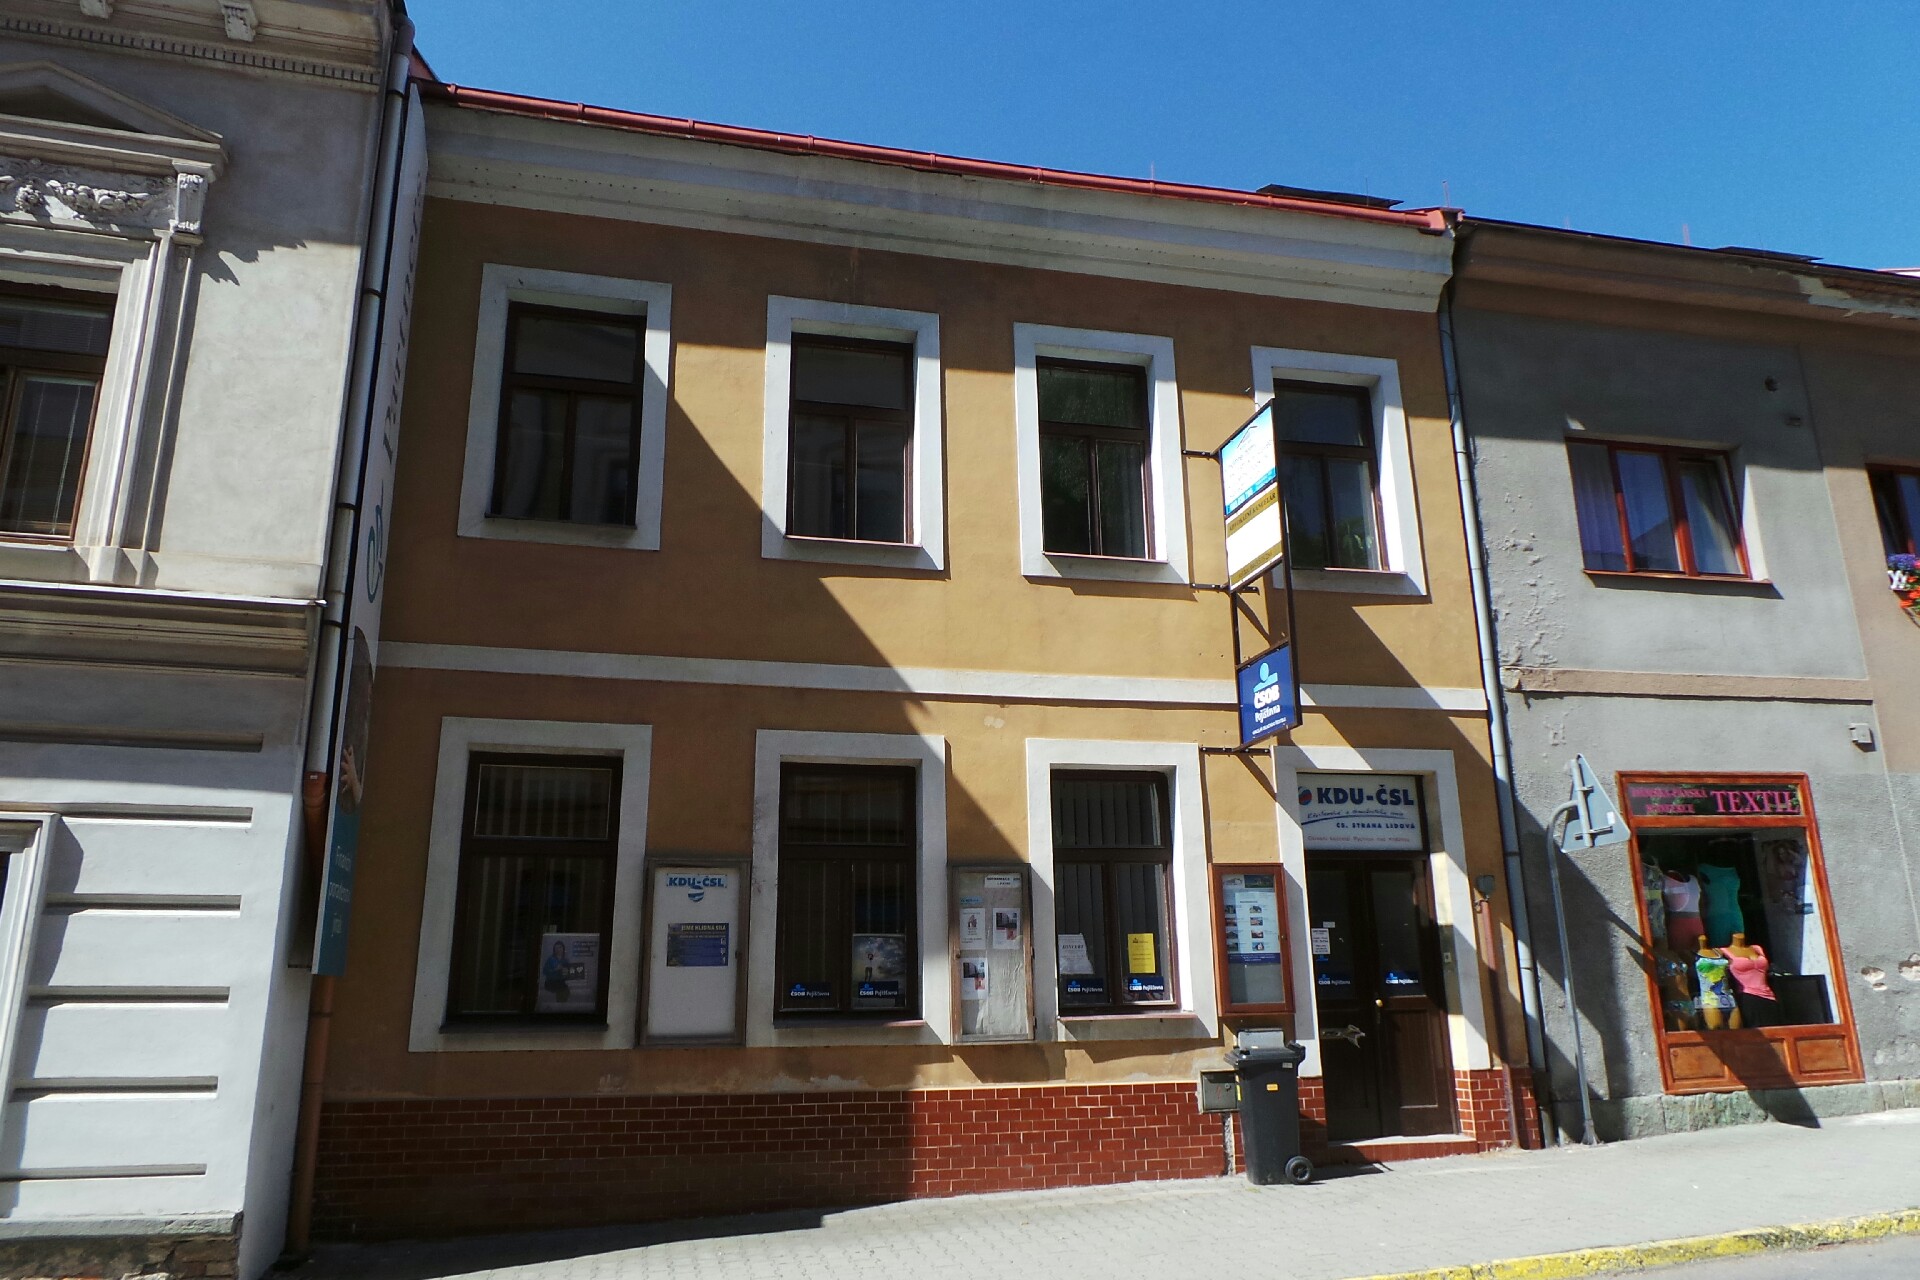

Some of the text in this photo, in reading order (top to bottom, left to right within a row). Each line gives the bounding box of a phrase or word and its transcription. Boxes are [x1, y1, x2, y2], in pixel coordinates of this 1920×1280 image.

[1253, 684, 1280, 709] ČSOB
[1316, 784, 1414, 806] KDU-ČSL
[1710, 790, 1800, 813] TEXTIL
[668, 875, 725, 889] KDU-ČSL
